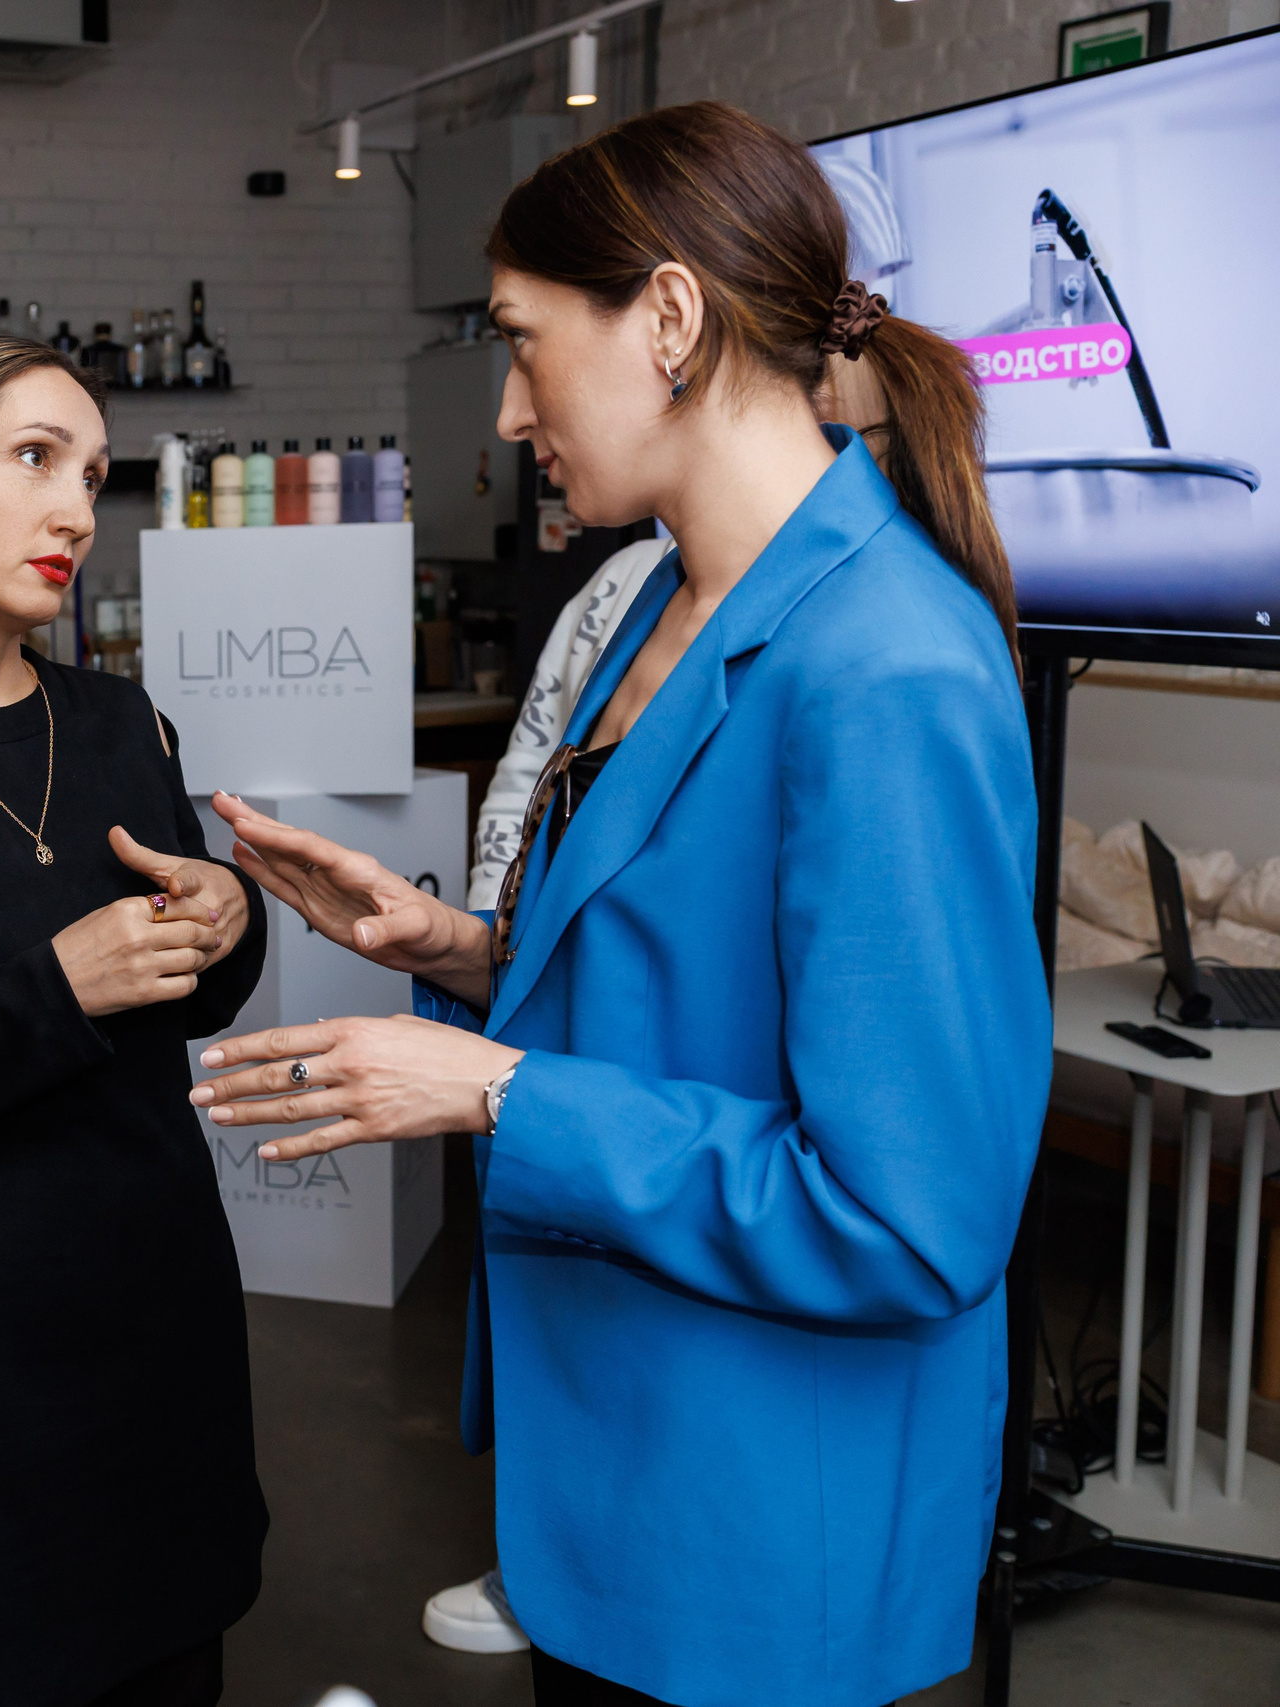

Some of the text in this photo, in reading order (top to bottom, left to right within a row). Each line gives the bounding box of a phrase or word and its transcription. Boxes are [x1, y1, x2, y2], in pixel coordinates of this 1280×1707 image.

[972, 338, 1125, 380] ВОДСТВО
[177, 626, 371, 680] LIMBA
[208, 683, 344, 699] COSMETICS
[208, 1137, 350, 1194] MBA
[221, 1188, 325, 1210] OSMETICS
